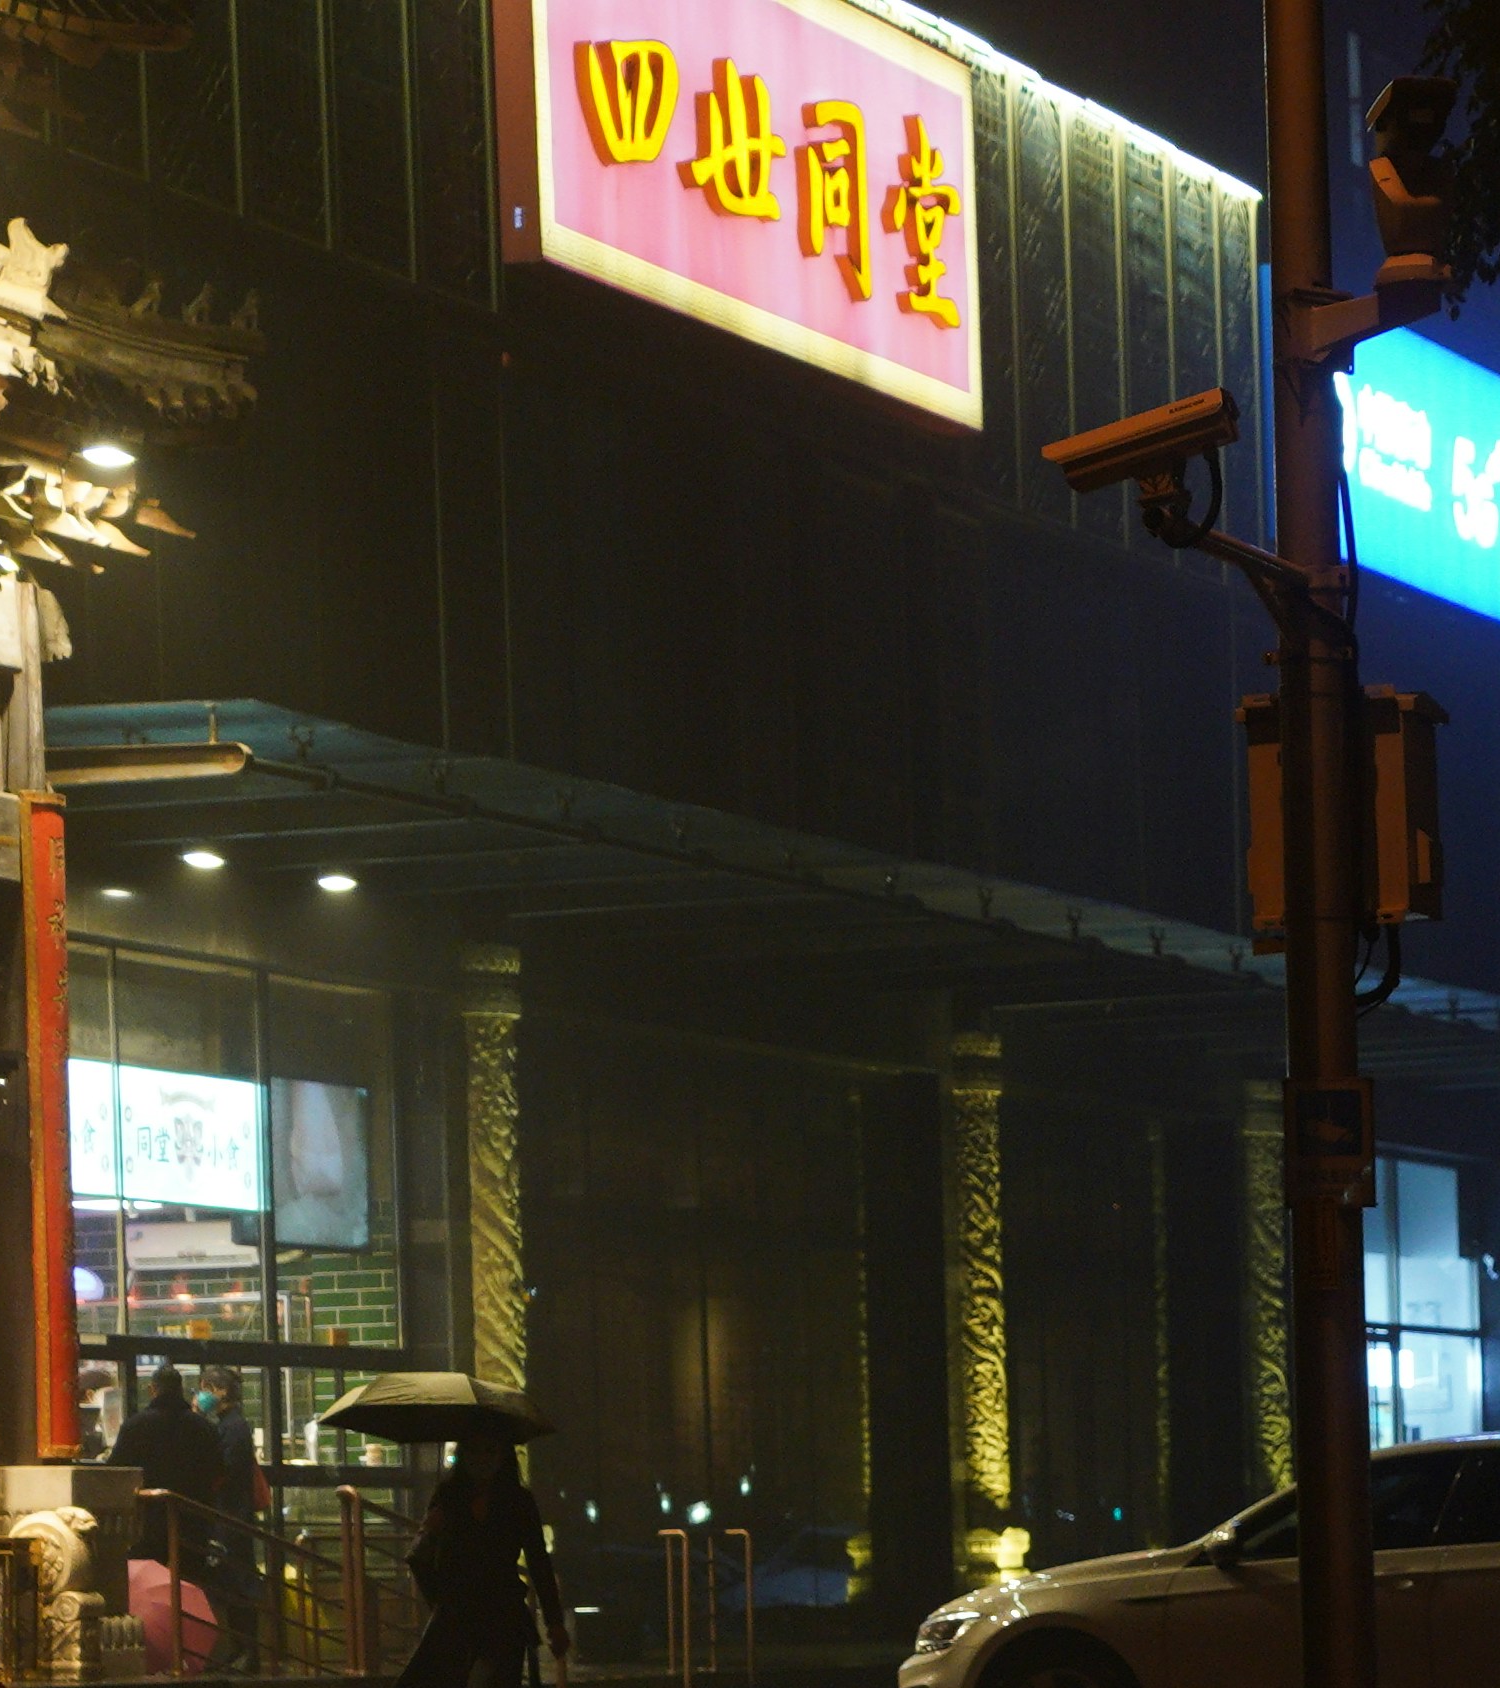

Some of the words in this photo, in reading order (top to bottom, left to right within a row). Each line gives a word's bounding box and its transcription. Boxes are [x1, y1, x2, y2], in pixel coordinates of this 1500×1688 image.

[573, 39, 962, 330] 四世同堂
[137, 1126, 171, 1163] 同堂
